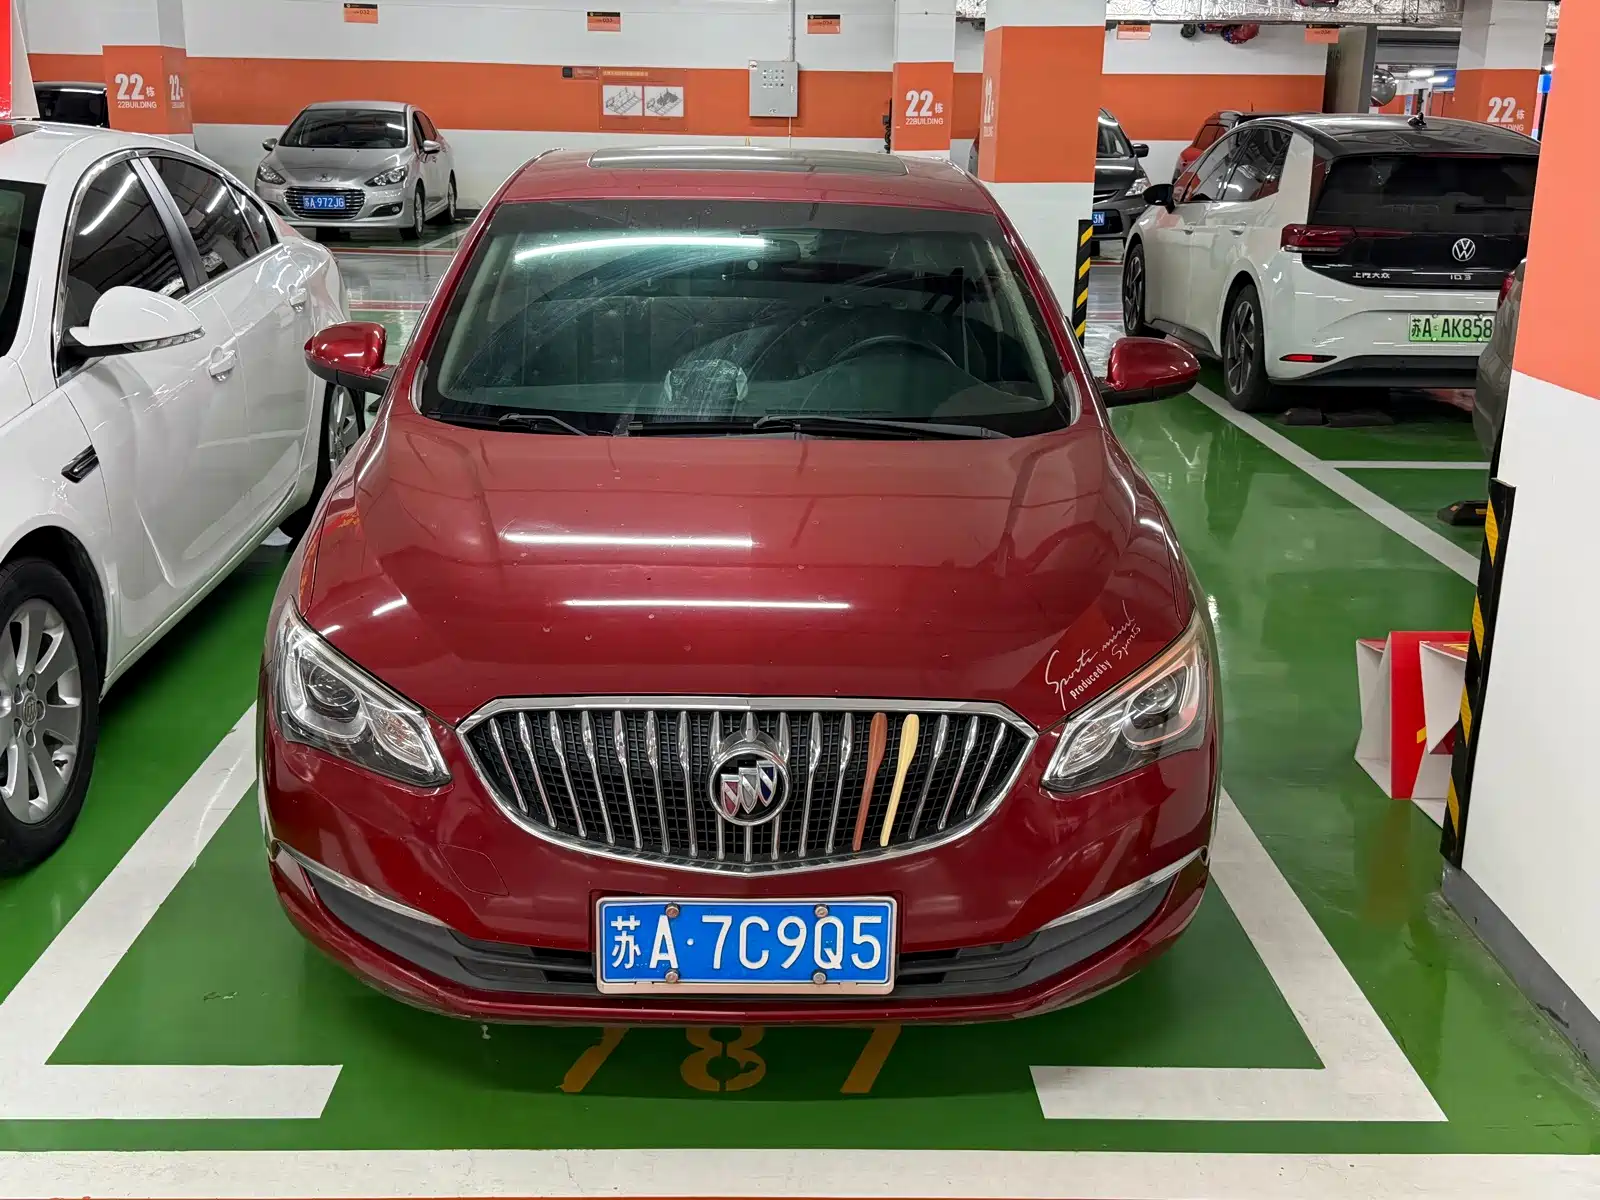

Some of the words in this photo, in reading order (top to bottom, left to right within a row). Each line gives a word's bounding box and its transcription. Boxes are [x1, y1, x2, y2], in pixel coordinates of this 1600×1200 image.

[117, 101, 157, 109] 22BUILDING
[905, 117, 944, 125] 22BUILDING
[1352, 271, 1391, 279] 上汽大众
